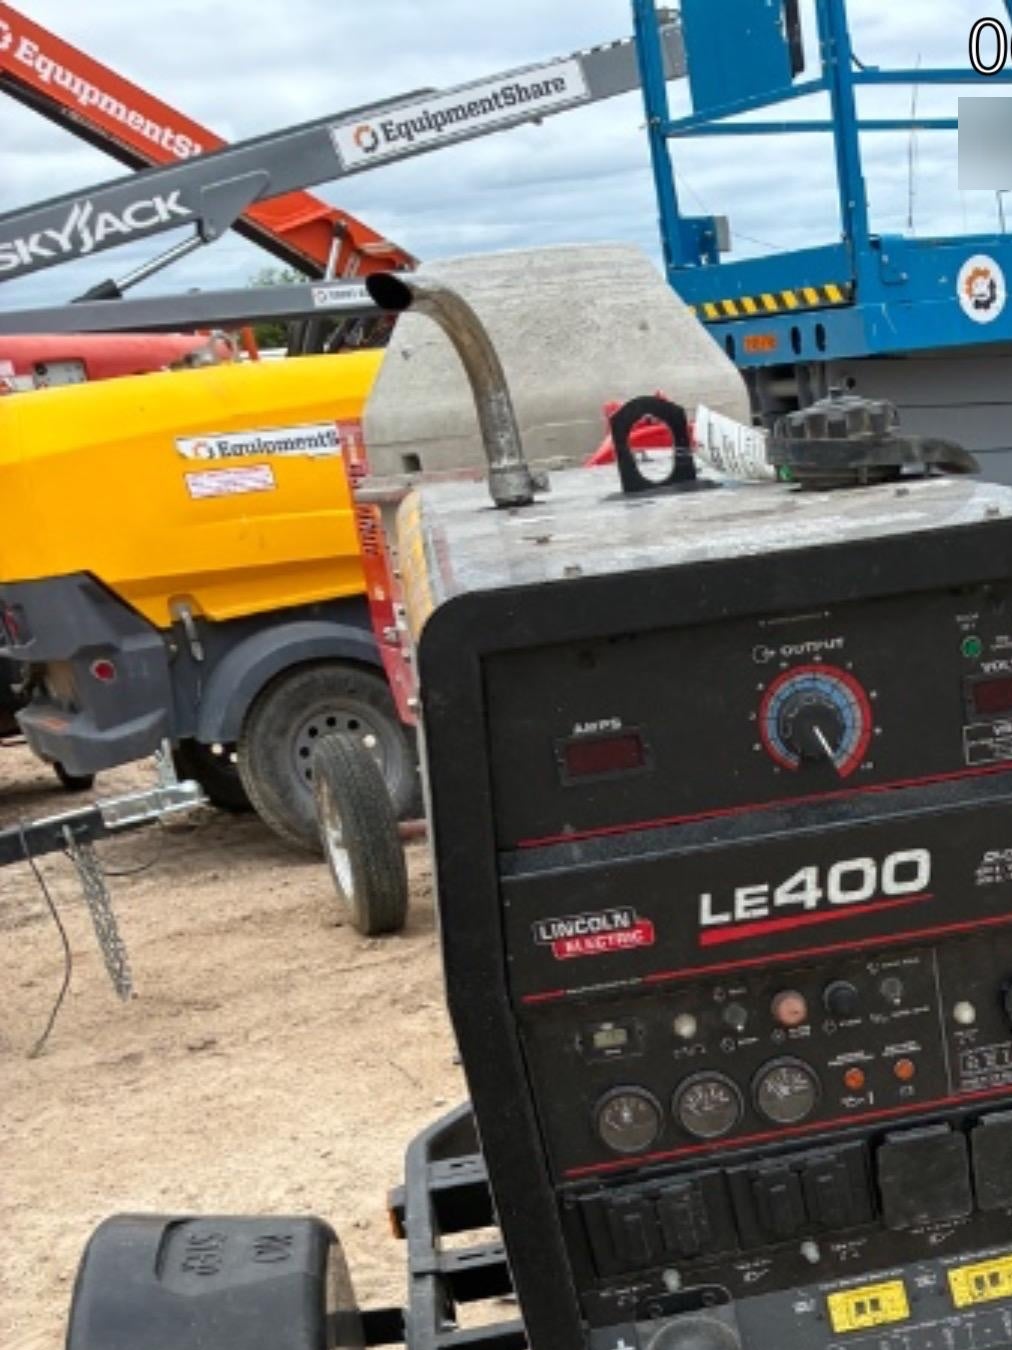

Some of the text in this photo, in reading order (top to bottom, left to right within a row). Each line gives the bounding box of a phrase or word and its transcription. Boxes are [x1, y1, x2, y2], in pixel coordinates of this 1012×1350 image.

[380, 76, 566, 142] EquipmentShare
[0, 190, 192, 271] SKYJACK
[780, 637, 844, 656] OUTPUT
[700, 848, 931, 925] LE400
[539, 911, 631, 941] LINCOLN
[565, 928, 643, 953] ELECTRIC
